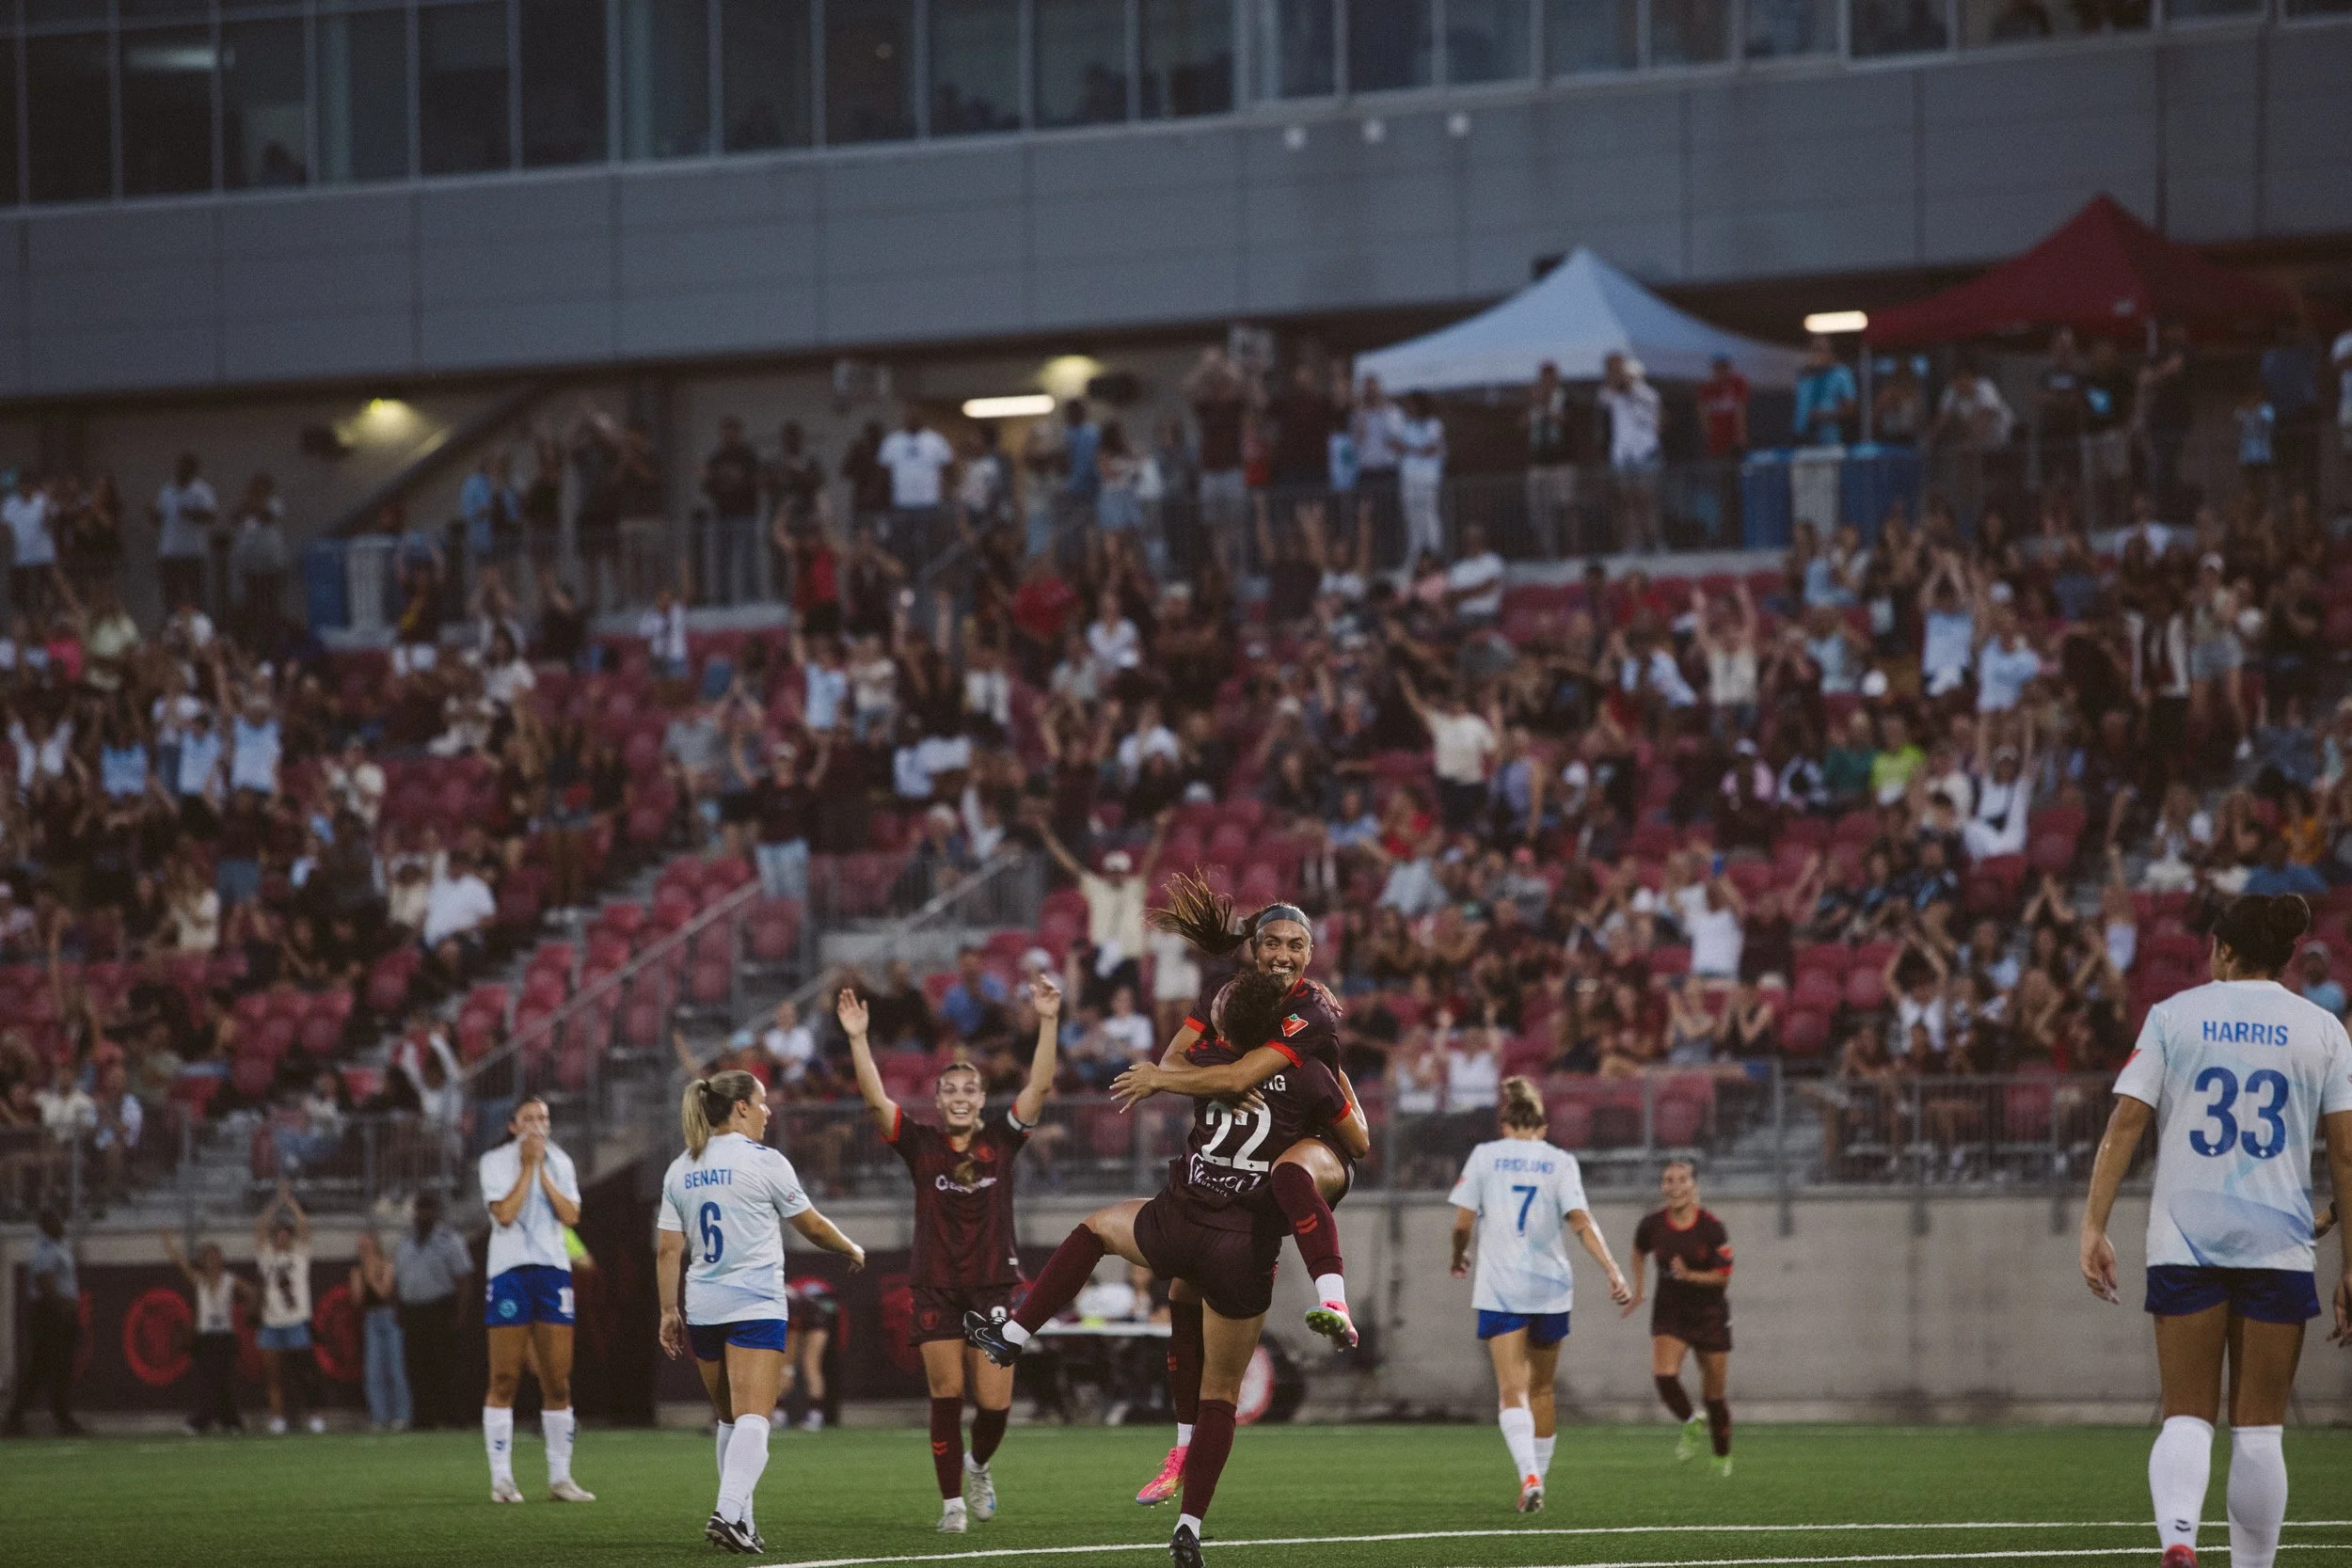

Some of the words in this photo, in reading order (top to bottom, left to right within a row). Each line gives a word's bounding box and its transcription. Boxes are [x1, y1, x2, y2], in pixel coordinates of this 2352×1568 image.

[2202, 1021, 2289, 1047] HARRIS
[1200, 1101, 1271, 1173] 22
[2189, 1067, 2290, 1160] 33
[684, 1169, 732, 1190] BENATI
[700, 1201, 723, 1263] 6
[1512, 1185, 1537, 1238] 7
